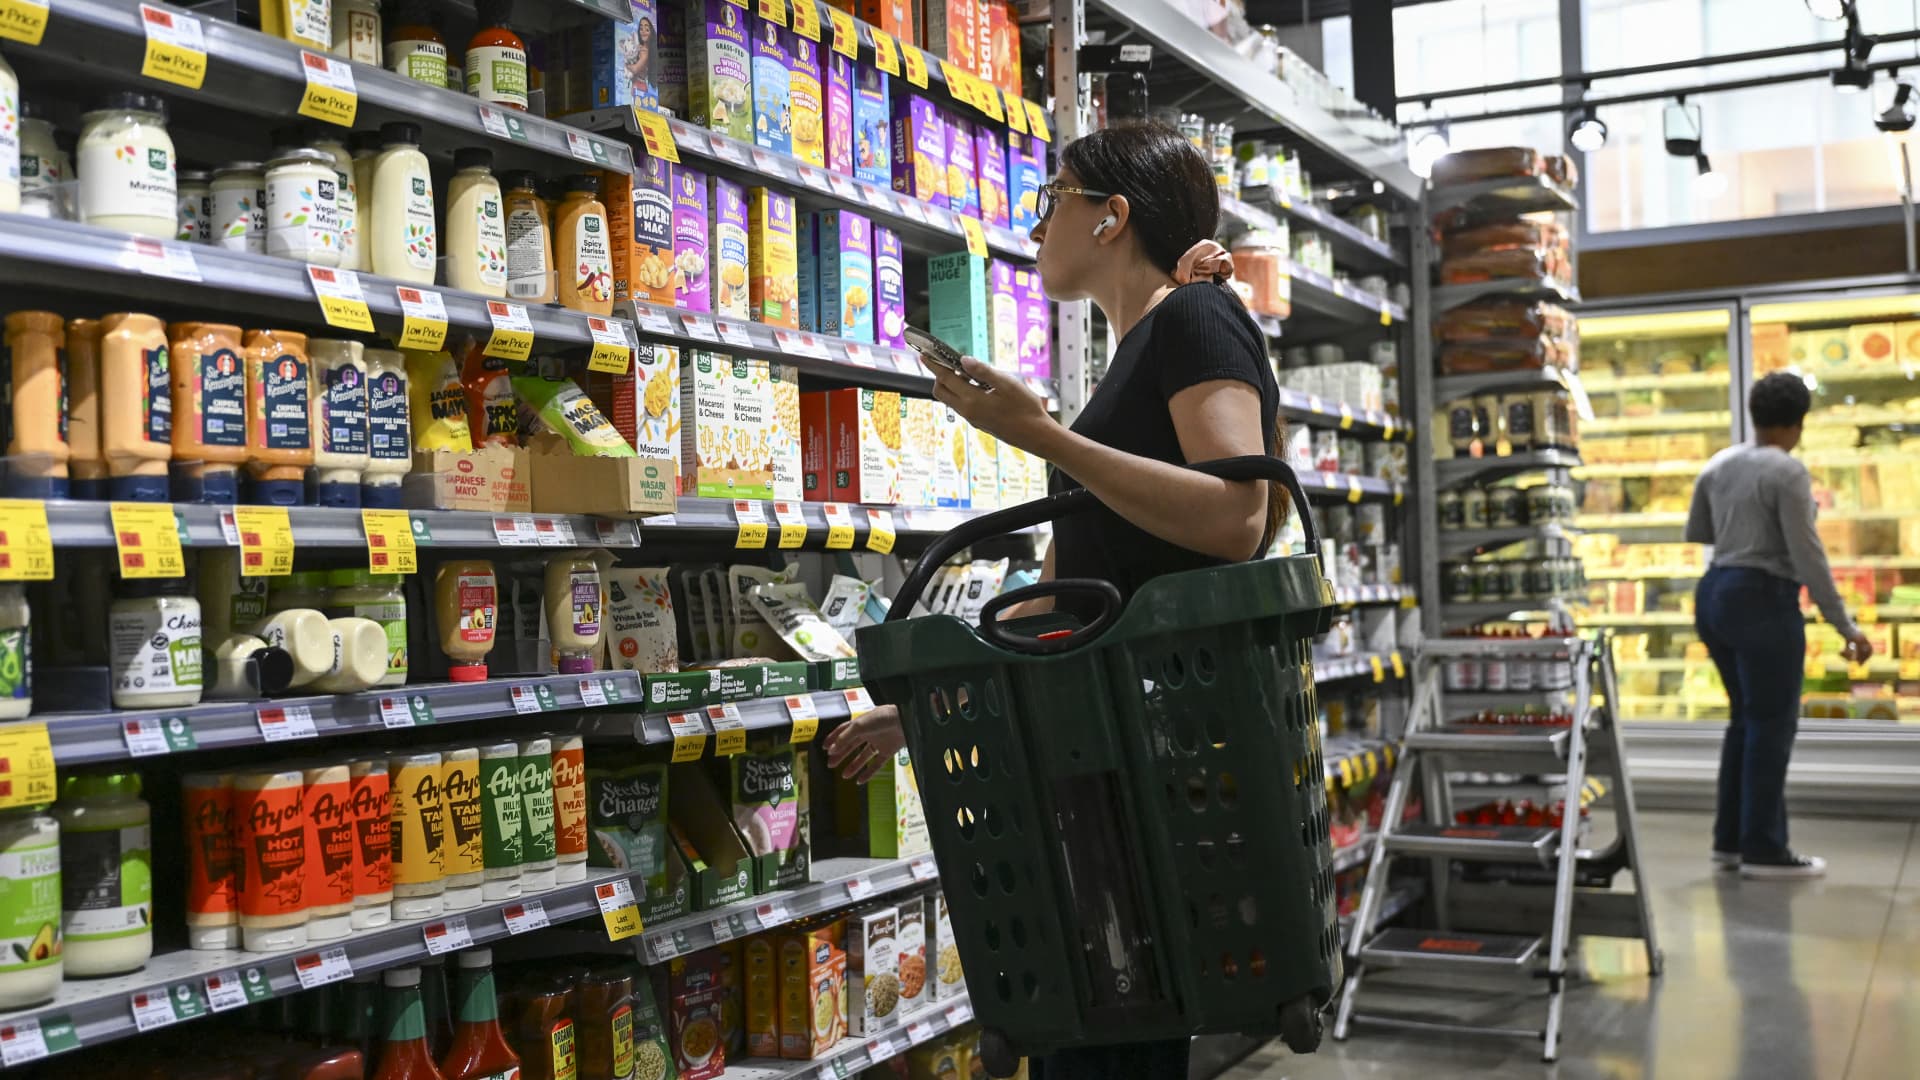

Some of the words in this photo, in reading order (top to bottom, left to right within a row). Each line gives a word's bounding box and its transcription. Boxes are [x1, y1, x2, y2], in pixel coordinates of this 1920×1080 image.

[715, 24, 743, 43] Annie's
[760, 43, 784, 60] Annie's
[151, 48, 171, 66] Low
[174, 52, 201, 73] Price
[720, 57, 741, 71] WHITE
[793, 57, 816, 75] Annie's
[714, 65, 747, 83] CHEDDAR
[308, 91, 327, 105] Low
[329, 96, 353, 113] Price
[895, 119, 904, 164] deluxe
[676, 195, 703, 211] Annie's
[636, 204, 670, 225] SUPER!
[585, 218, 599, 228] 365
[643, 221, 664, 235] MAC
[676, 225, 704, 242] CHEDDAR
[583, 239, 602, 250] Spicy
[581, 246, 605, 256] Harissa
[931, 259, 955, 272] THIS
[956, 254, 967, 267] IS
[930, 268, 961, 283] HUGE
[326, 304, 343, 315] Low
[406, 325, 422, 338] Low
[423, 326, 444, 339] Price
[492, 336, 509, 348] Low
[510, 338, 530, 350] Price
[594, 349, 609, 360] Low
[610, 350, 628, 363] Price
[640, 346, 653, 358] 365
[699, 354, 712, 365] 365
[735, 361, 747, 372] 365
[698, 398, 725, 409] Macaroni
[734, 402, 762, 414] Macaroni
[699, 408, 704, 417] &
[704, 409, 725, 419] Cheese
[734, 413, 740, 422] &
[740, 413, 762, 423] Cheese
[640, 443, 670, 455] Macaroni
[455, 485, 478, 496] MAYO
[640, 479, 666, 491] WASABI
[643, 489, 663, 501] MAYO
[741, 529, 751, 539] Low
[752, 529, 766, 540] Price
[782, 530, 792, 540] Low
[831, 530, 840, 540] Low
[235, 601, 261, 614] MAYO
[653, 684, 665, 696] 365
[794, 725, 805, 735] Low
[718, 736, 731, 747] Low
[731, 734, 745, 746] Price
[676, 742, 689, 753] Low
[746, 759, 785, 775] Seeds
[601, 780, 650, 797] Seeds
[533, 797, 545, 807] DILL
[563, 800, 585, 810] MAY
[600, 795, 659, 818] Change
[267, 837, 299, 851] HOT
[615, 915, 628, 924] Last
